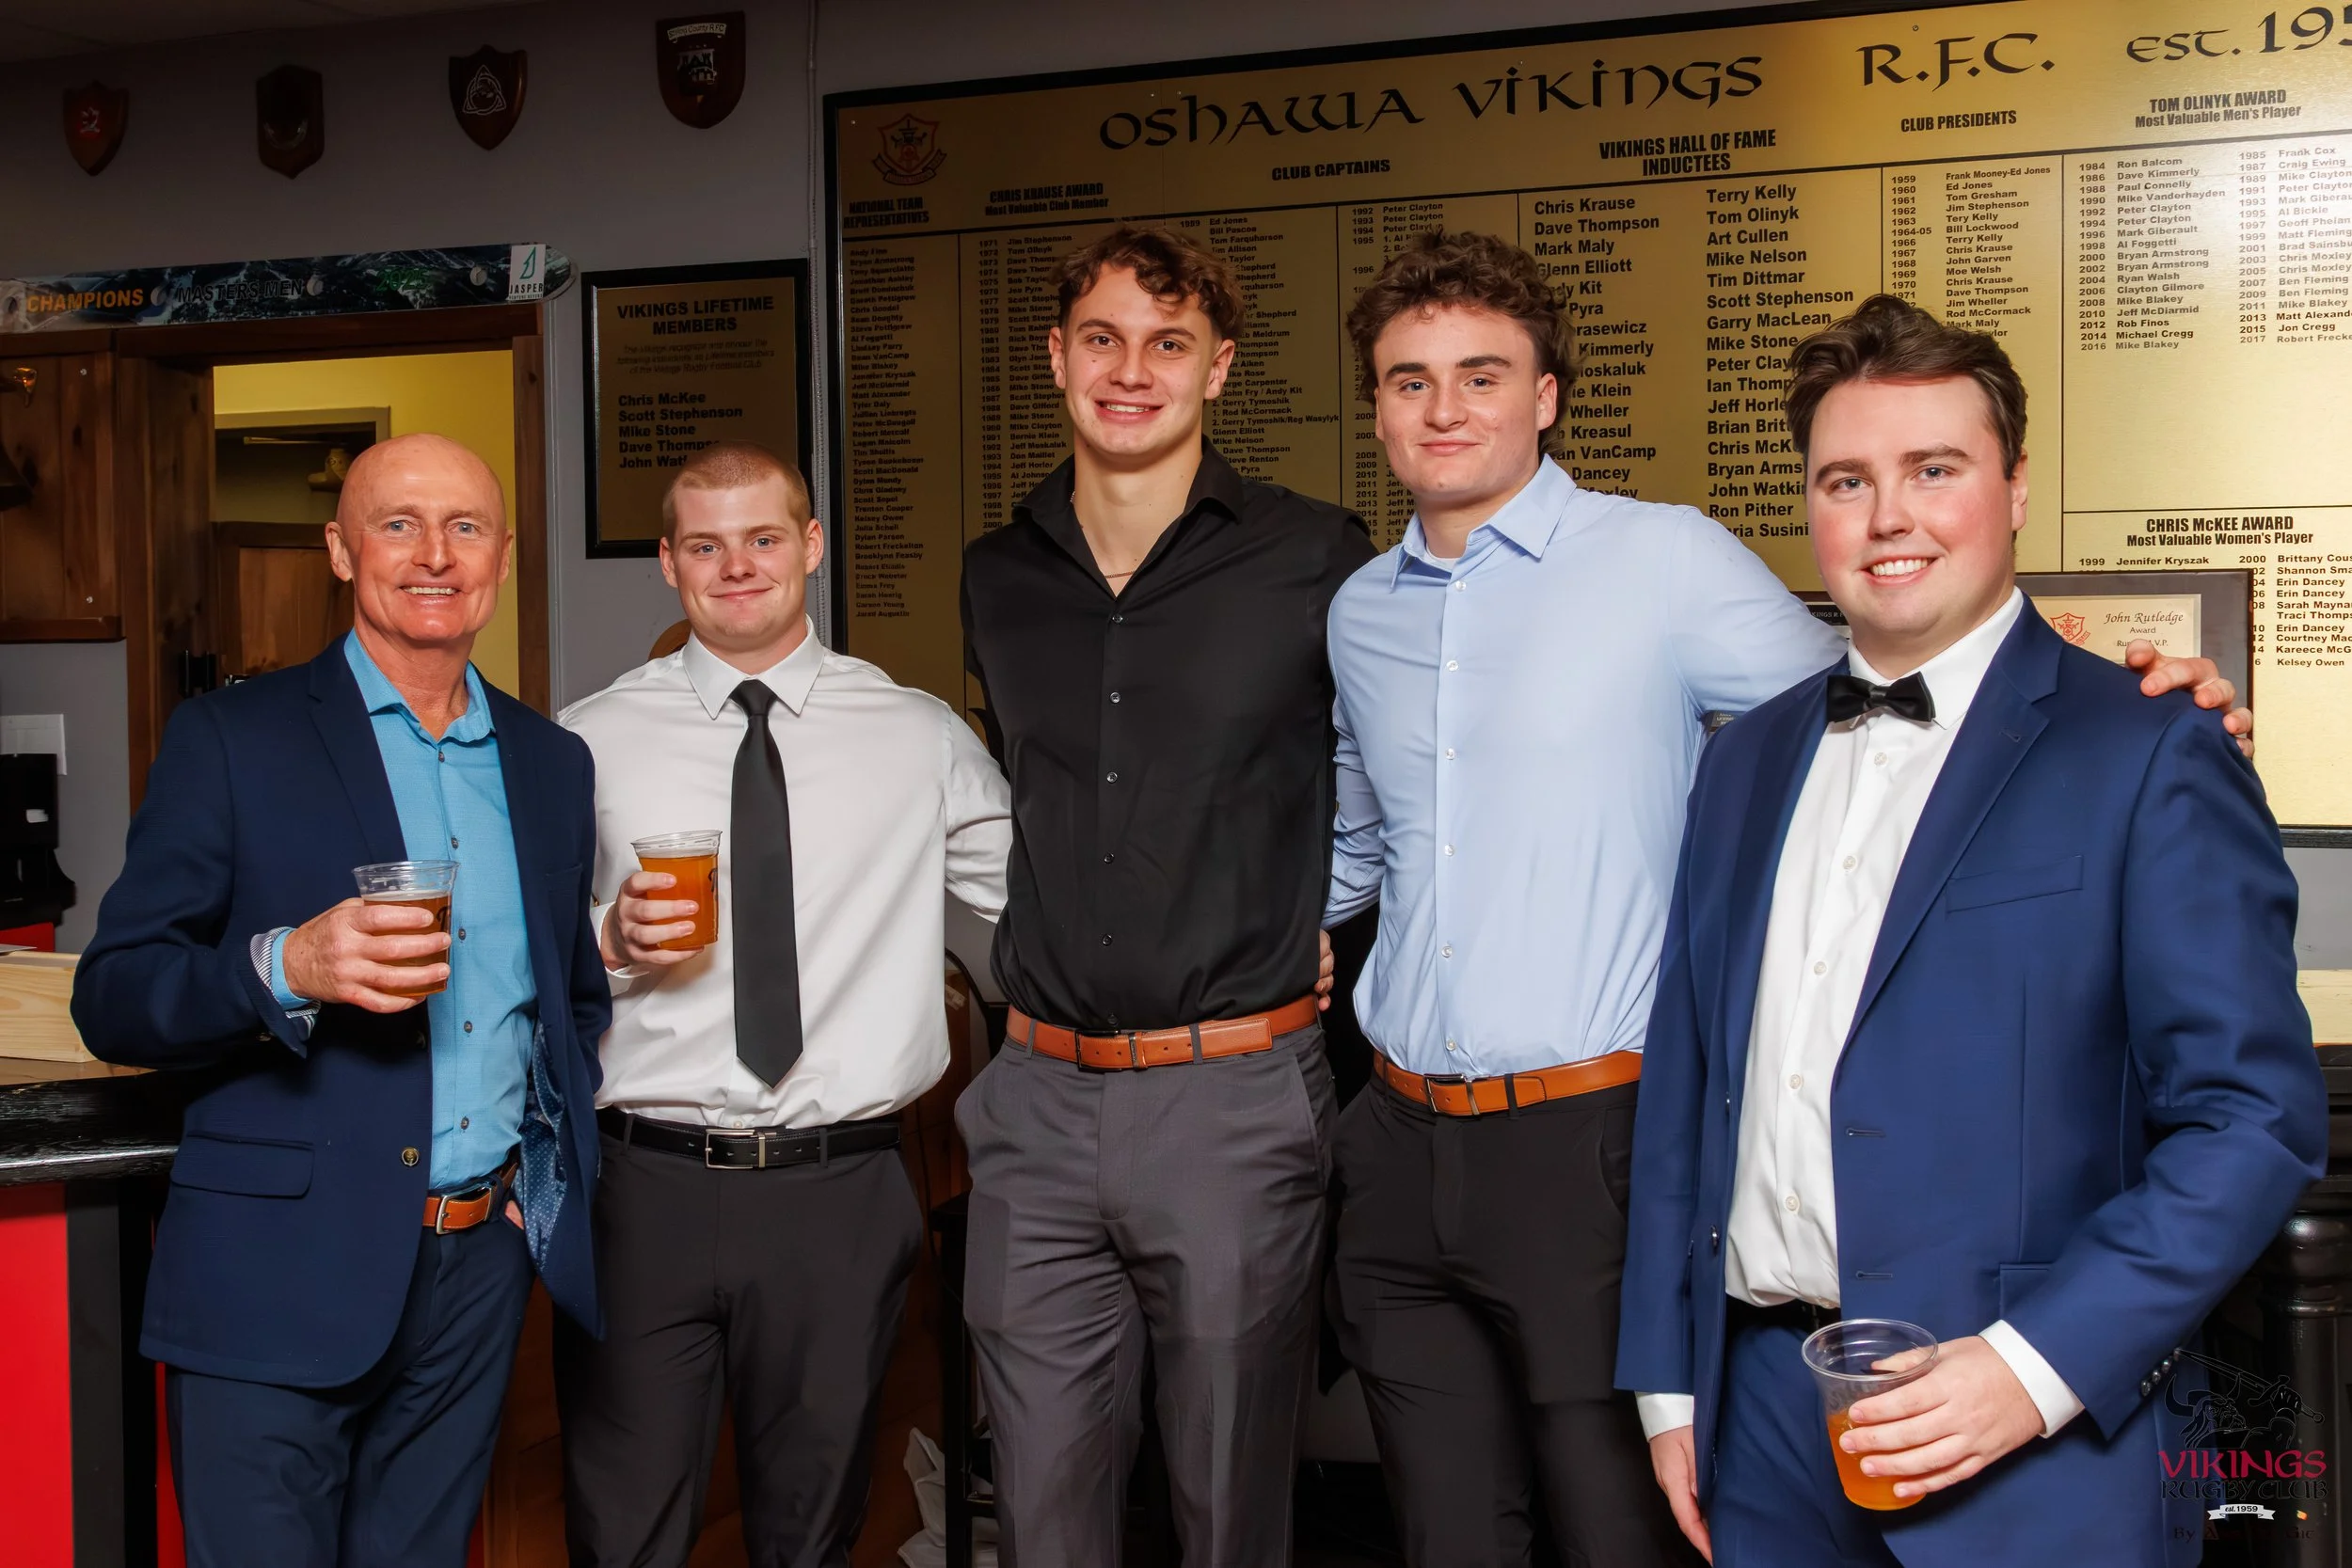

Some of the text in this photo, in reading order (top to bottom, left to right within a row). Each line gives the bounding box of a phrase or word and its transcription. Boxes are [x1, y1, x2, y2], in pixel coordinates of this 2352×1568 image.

[1856, 33, 2055, 91] R.F.C.
[2150, 89, 2286, 113] TOM OLINYK AWARD
[1900, 110, 2017, 133] CLUB PRESIDENTS
[2136, 105, 2301, 128] Most Valuable Men's Player
[1599, 130, 1776, 159] VIKINGS HALL OF FAME
[1272, 159, 1391, 181] CLUB CAPTAINS
[1643, 153, 1730, 177] INDUCTEES
[1974, 168, 2021, 179] Mooney-Ed
[990, 190, 1022, 202] CHRIS
[1065, 183, 1103, 198] AWARD
[1707, 184, 1796, 205] Terry Kelly
[1892, 197, 1915, 205] 1961
[1972, 191, 2017, 199] Gresham
[2147, 189, 2226, 201] Vanderhayden
[896, 198, 923, 210] TEAM
[985, 204, 1007, 215] Most
[1009, 201, 1047, 214] Valuable
[1050, 199, 1070, 211] Club
[1353, 203, 1443, 215] 1992 Peter Clayton
[1534, 198, 1635, 215] Chris Krause
[844, 211, 930, 228] REPRESENTATIVES
[1707, 207, 1799, 225] Tom Olinyk
[1534, 217, 1660, 235] Dave Thompson
[1966, 222, 2019, 231] Lockwood
[1707, 229, 1788, 245] Art Cullen
[1534, 240, 1614, 257] Mark Maly
[1707, 248, 1807, 266] Mike Nelson
[1585, 259, 1632, 274] Elliott
[1707, 270, 1804, 288] Tim Dittmar
[510, 283, 543, 293] JASPER
[1580, 282, 1602, 294] Kit
[27, 289, 143, 313] CHAMPIONS
[179, 282, 260, 303] MASTERS
[264, 280, 302, 297] MEN
[1707, 290, 1853, 309] Scott Stephenson
[617, 296, 773, 319] VIKINGS LIFETIME
[1569, 303, 1604, 318] Pyra
[1969, 307, 2031, 316] McCormack
[653, 317, 737, 335] MEMBERS
[1707, 312, 1831, 331] Garry MacLean
[2162, 330, 2193, 339] Cregg
[1579, 341, 1654, 357] Kimmerly
[1707, 335, 1798, 351] Mike Stone
[1592, 385, 1631, 397] Klein
[619, 392, 706, 406] Chris McKee
[1223, 399, 1246, 407] Gerry
[1249, 397, 1290, 406] Tymoshik
[619, 407, 743, 421] Scott Stephenson
[1570, 405, 1629, 419] Wheller
[619, 425, 696, 437] Mike Stone
[1571, 424, 1631, 439] Kreasul
[619, 442, 652, 452] Dave
[1581, 445, 1656, 461] VanCamp
[619, 456, 652, 468] John
[1572, 467, 1630, 482] Dancey
[1709, 502, 1794, 517] Ron Pither
[1759, 522, 1809, 537] Susini
[2146, 516, 2293, 532] CHRIS McKEE AWARD
[2127, 531, 2313, 546] Most Valuable Women's Player
[2116, 557, 2161, 565] Jennifer
[2165, 557, 2210, 566] Kryszak
[2239, 554, 2324, 563] 2000 Brittany
[2303, 578, 2344, 587] Dancey
[2104, 611, 2184, 624] John Rutledge
[2303, 624, 2344, 633] Dancey
[2276, 634, 2328, 643] Courtney
[2276, 645, 2324, 654] Kareece
[2277, 658, 2312, 667] Kelsey
